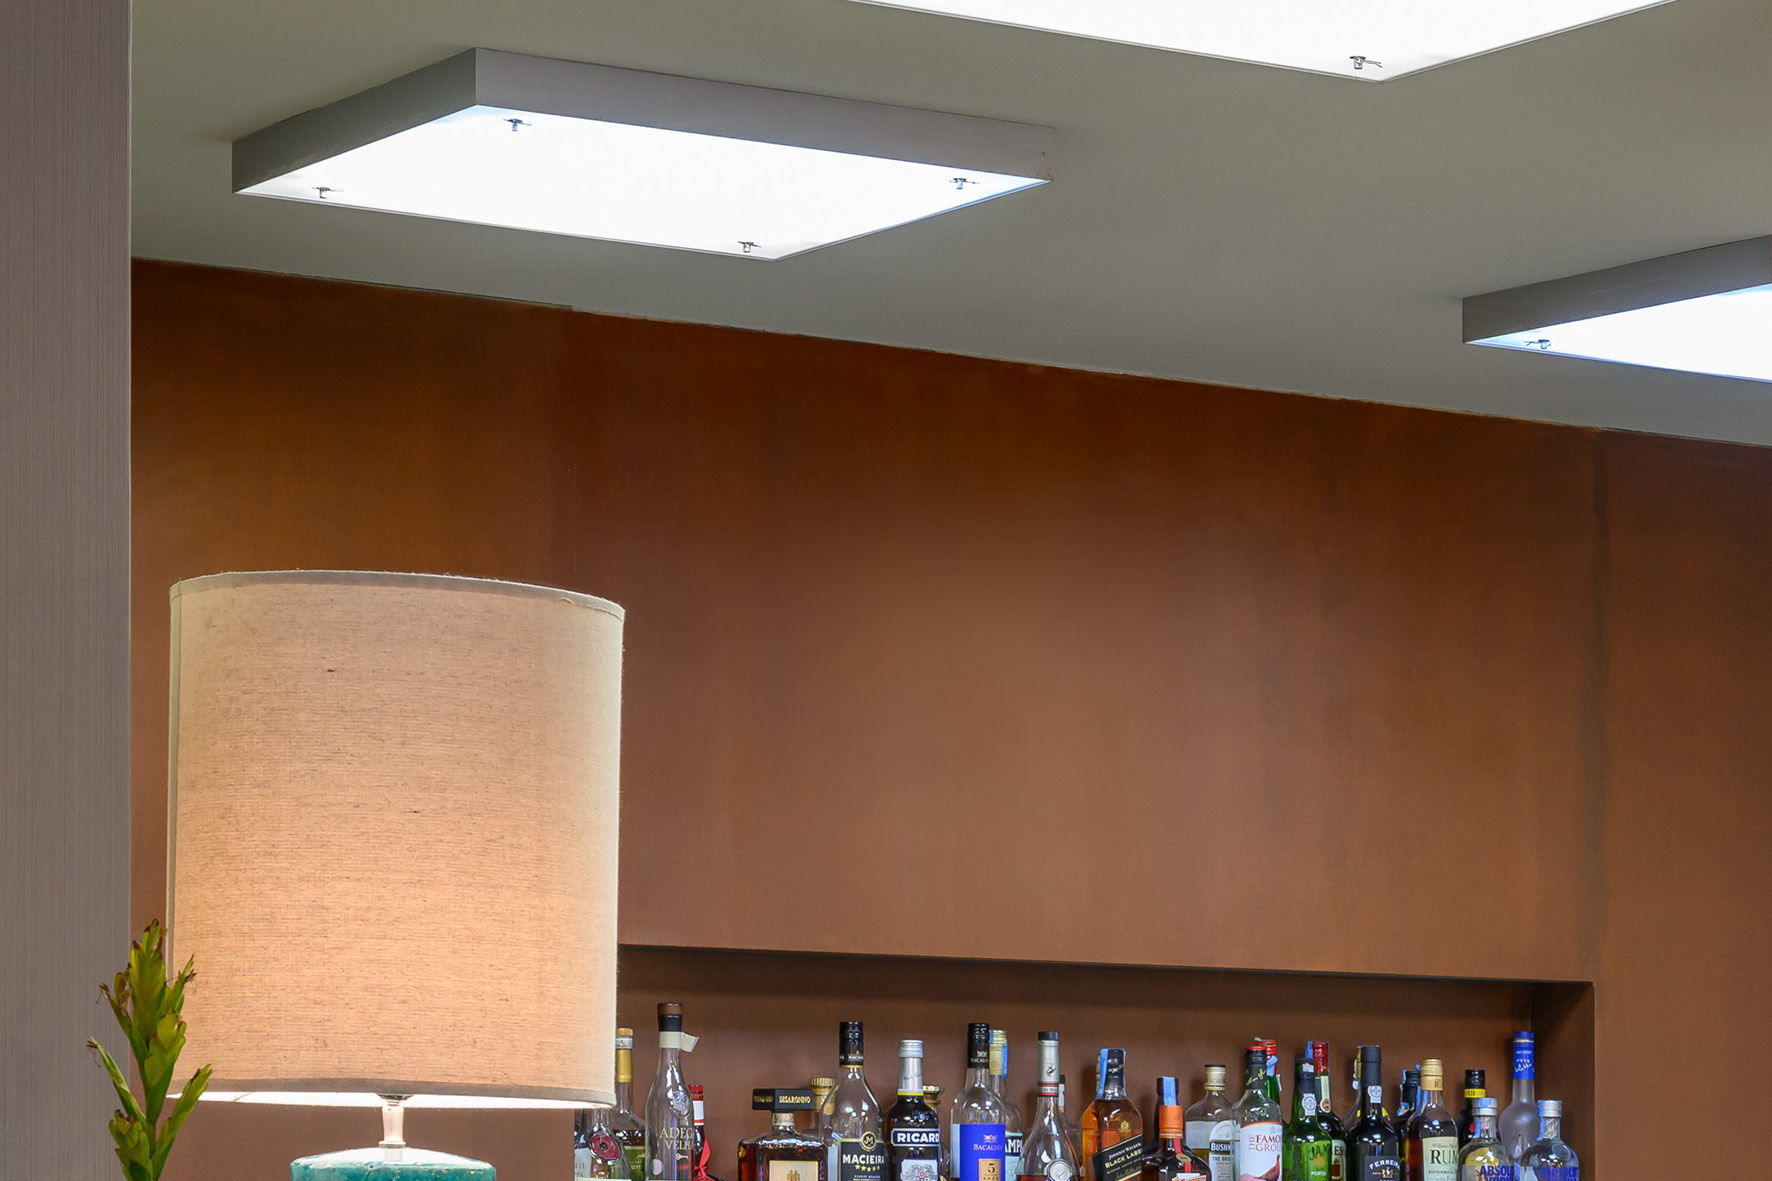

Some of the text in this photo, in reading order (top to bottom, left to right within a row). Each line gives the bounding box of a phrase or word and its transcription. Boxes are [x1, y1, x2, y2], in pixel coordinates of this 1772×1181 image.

[779, 1096, 811, 1104] DISARONNO
[659, 1127, 693, 1139] ADEG
[897, 1132, 940, 1143] RICARD
[842, 1154, 885, 1164] MACIEIRA
[1105, 1155, 1126, 1169] BLACK
[988, 1162, 995, 1173] 5
